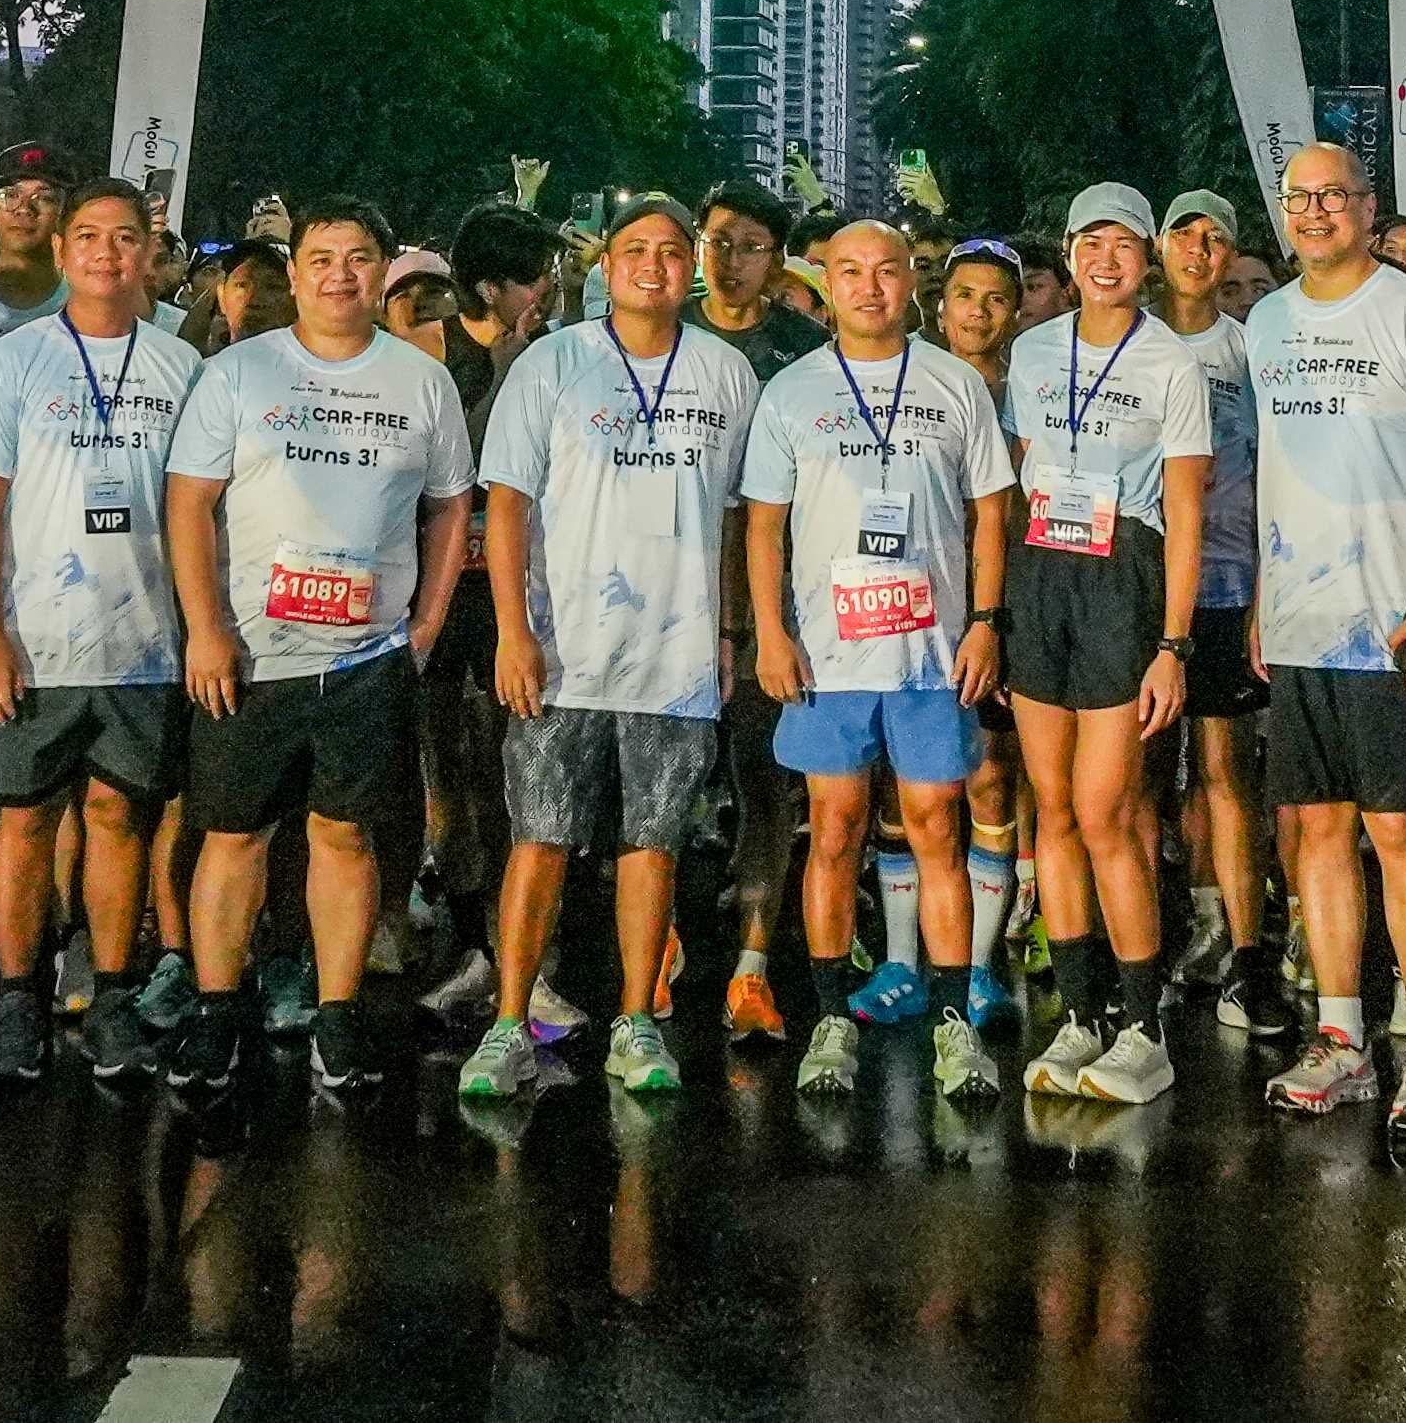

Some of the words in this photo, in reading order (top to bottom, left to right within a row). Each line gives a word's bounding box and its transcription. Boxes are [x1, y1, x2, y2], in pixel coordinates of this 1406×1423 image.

[1361, 104, 1377, 192] USICAL
[1296, 358, 1380, 376] CAR-FREE
[1272, 397, 1323, 415] turns
[1328, 397, 1346, 415] 3!
[312, 407, 410, 430] CAR-FREE
[322, 425, 401, 442] sundays
[656, 425, 720, 444] undays
[1094, 420, 1110, 437] 3!
[71, 430, 125, 449] turns
[132, 432, 148, 449] 3!
[903, 440, 920, 456] 3!
[286, 441, 351, 465] turns
[358, 448, 379, 467] 3!
[613, 446, 676, 467] turns
[684, 448, 702, 467] 3!
[91, 512, 125, 529] VIP
[1053, 522, 1084, 543] VIP
[865, 534, 899, 554] VIP
[272, 573, 349, 603] 61089
[836, 585, 908, 615] 61090
